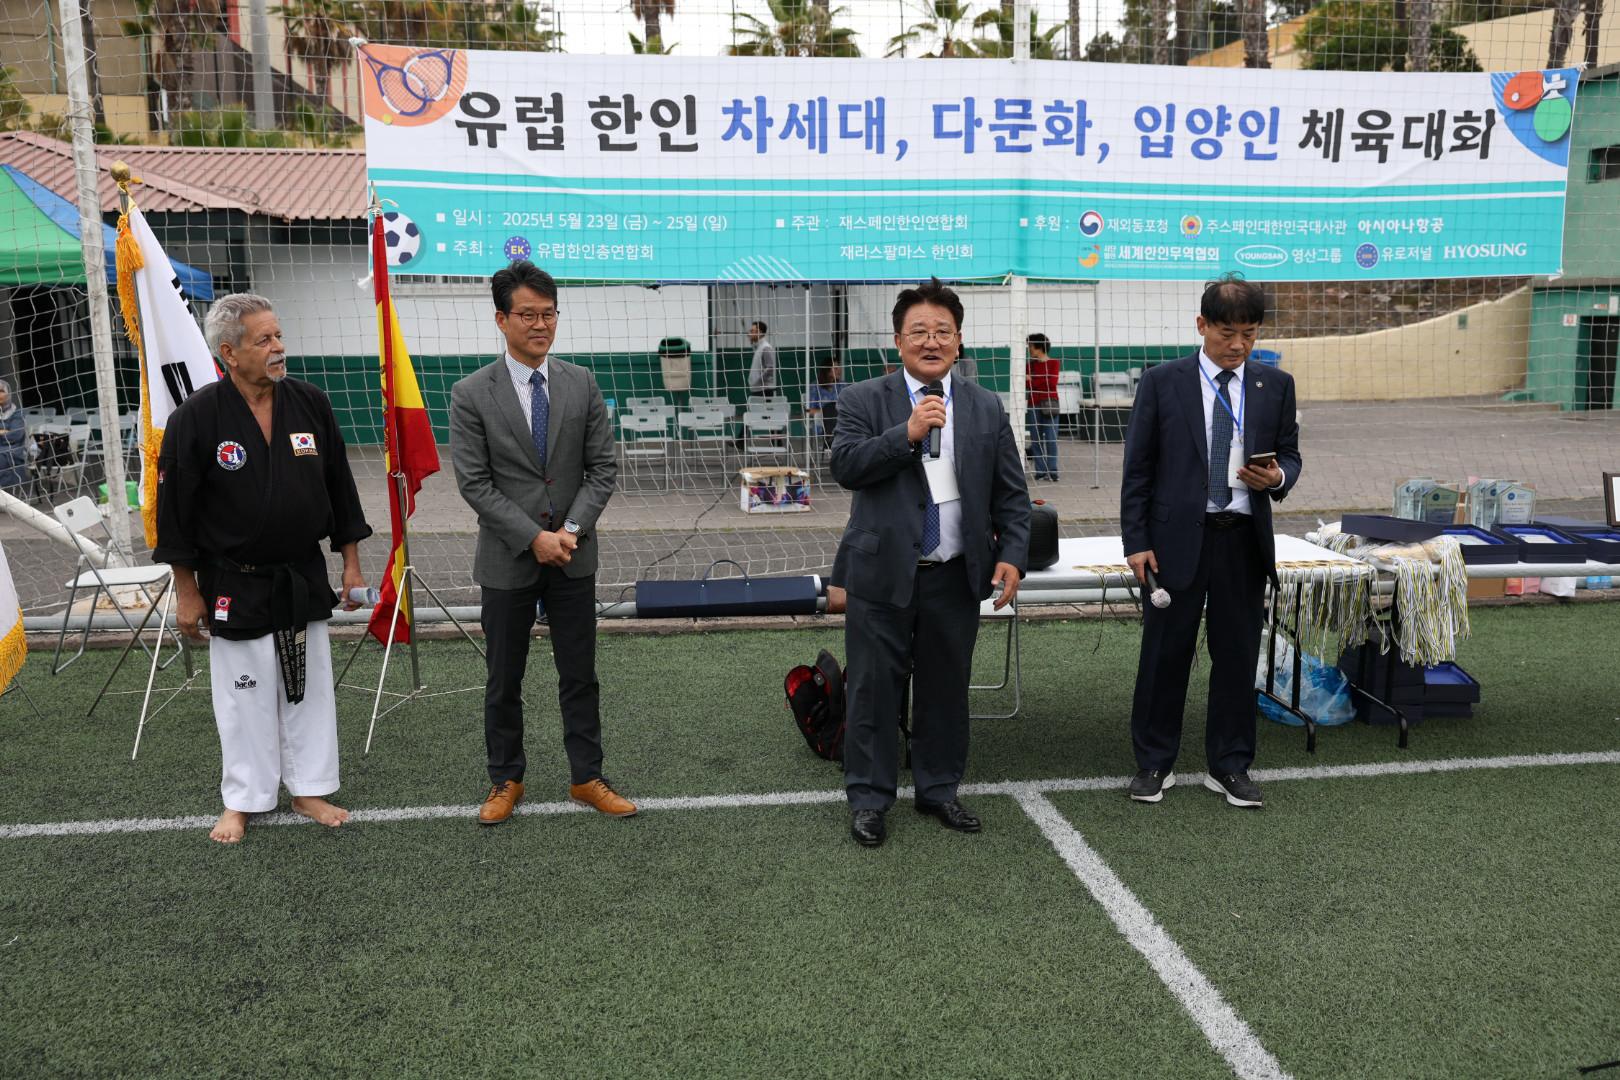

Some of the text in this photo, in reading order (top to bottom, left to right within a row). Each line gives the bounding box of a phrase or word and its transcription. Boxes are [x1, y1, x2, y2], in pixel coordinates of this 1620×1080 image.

[455, 91, 1498, 164] 유럽 한인 차세대, 다문화, 입양인 체육대회
[452, 209, 482, 226] 일시
[503, 212, 554, 229] 2025년
[559, 212, 582, 230] 5월
[587, 214, 618, 230] 23일
[623, 214, 648, 231] (금)
[667, 215, 698, 232] 25일
[703, 215, 728, 232] (일)
[791, 215, 820, 232] 주관
[839, 214, 968, 231] 재스페인한인연합회
[1034, 215, 1061, 232] 후원
[1107, 218, 1168, 234] 재외동포청
[1207, 218, 1347, 236] 주스페인대한민국대사관
[1357, 217, 1444, 235] 아시아나항공
[453, 240, 483, 257] 주최
[510, 245, 525, 256] EK
[537, 242, 653, 261] 유럽한인총연합회
[840, 244, 973, 261] 재라스팔마스 한인회
[1118, 245, 1220, 262] 세계한인무역협회
[1292, 247, 1341, 264] 영산그룹
[1382, 246, 1432, 261] 유로저널
[1443, 242, 1527, 259] HYOSUNG
